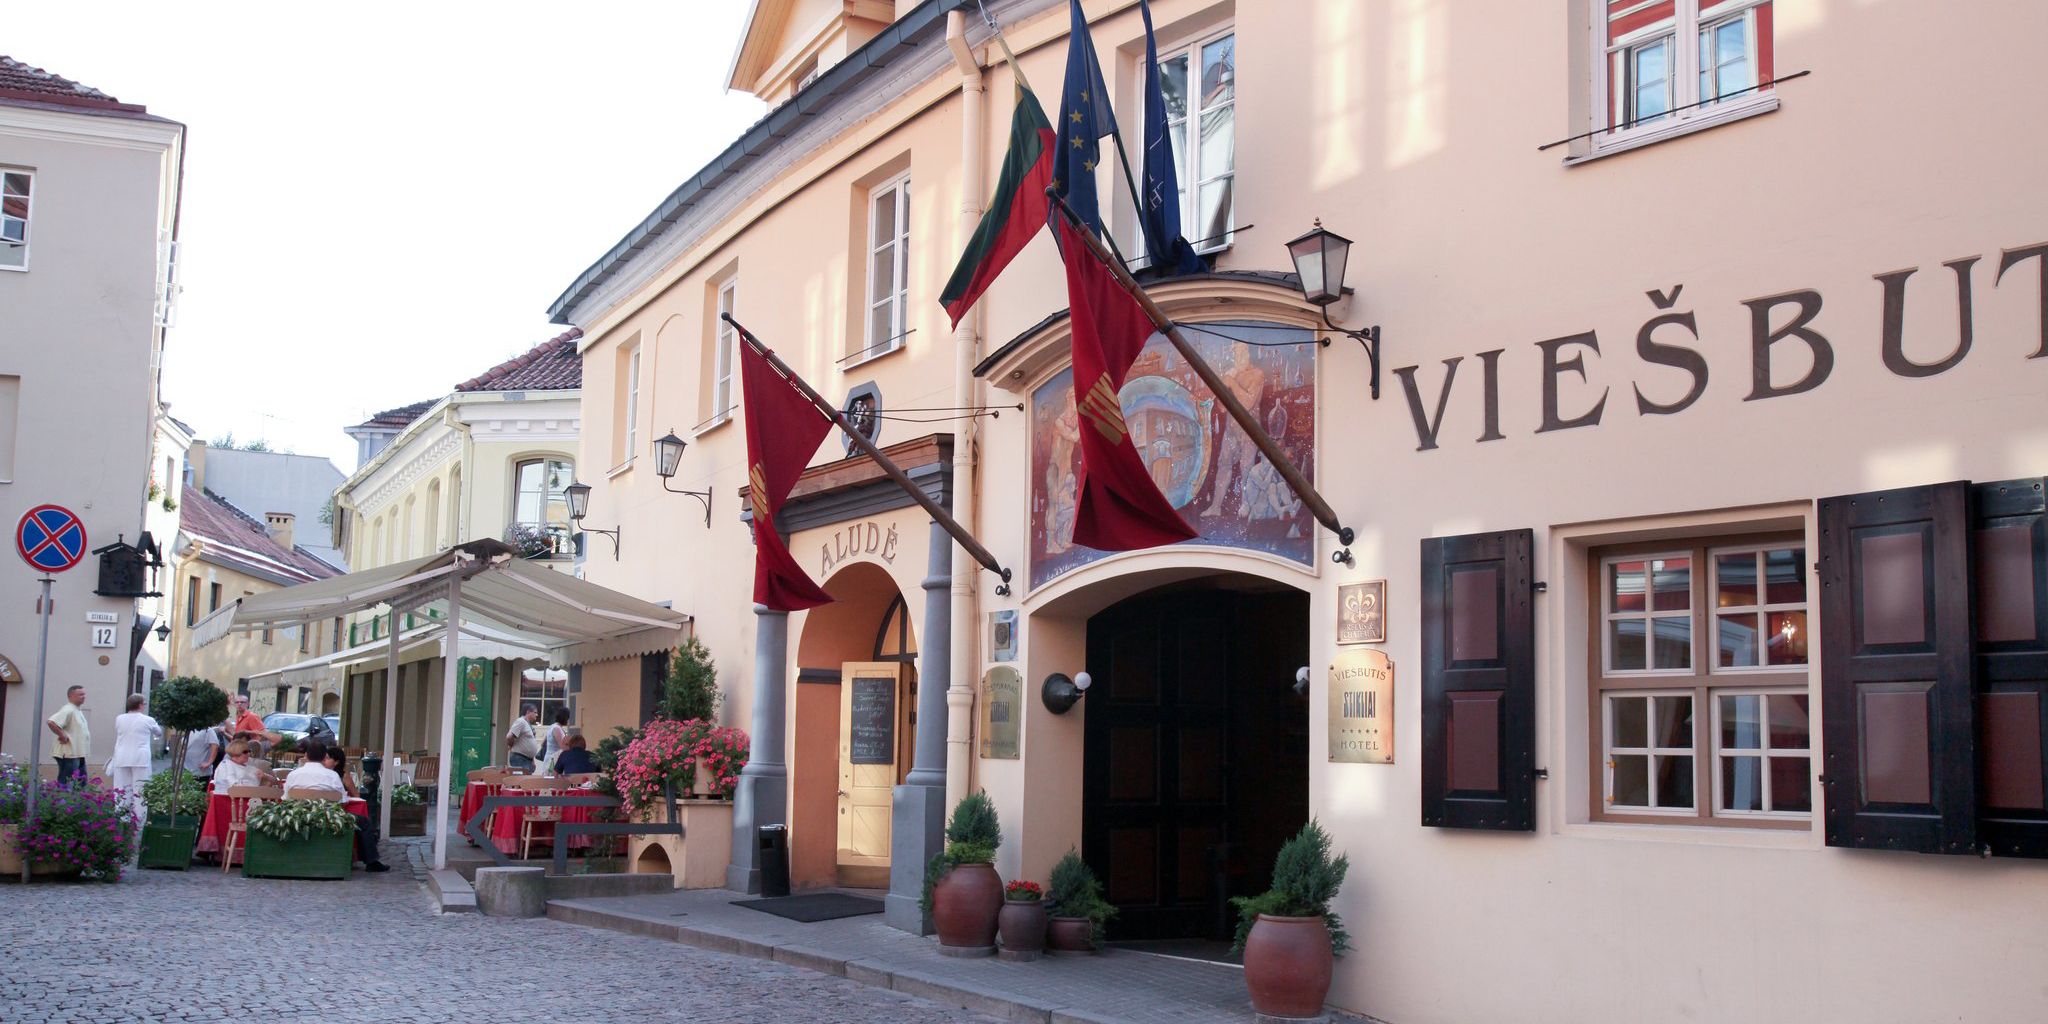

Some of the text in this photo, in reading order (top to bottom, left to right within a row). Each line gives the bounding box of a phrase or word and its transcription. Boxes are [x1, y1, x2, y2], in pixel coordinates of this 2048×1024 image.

[821, 521, 898, 576] ALUDĖ
[97, 628, 112, 645] 12
[1343, 691, 1376, 719] STIKLIAI
[1340, 740, 1379, 751] HOTEL
